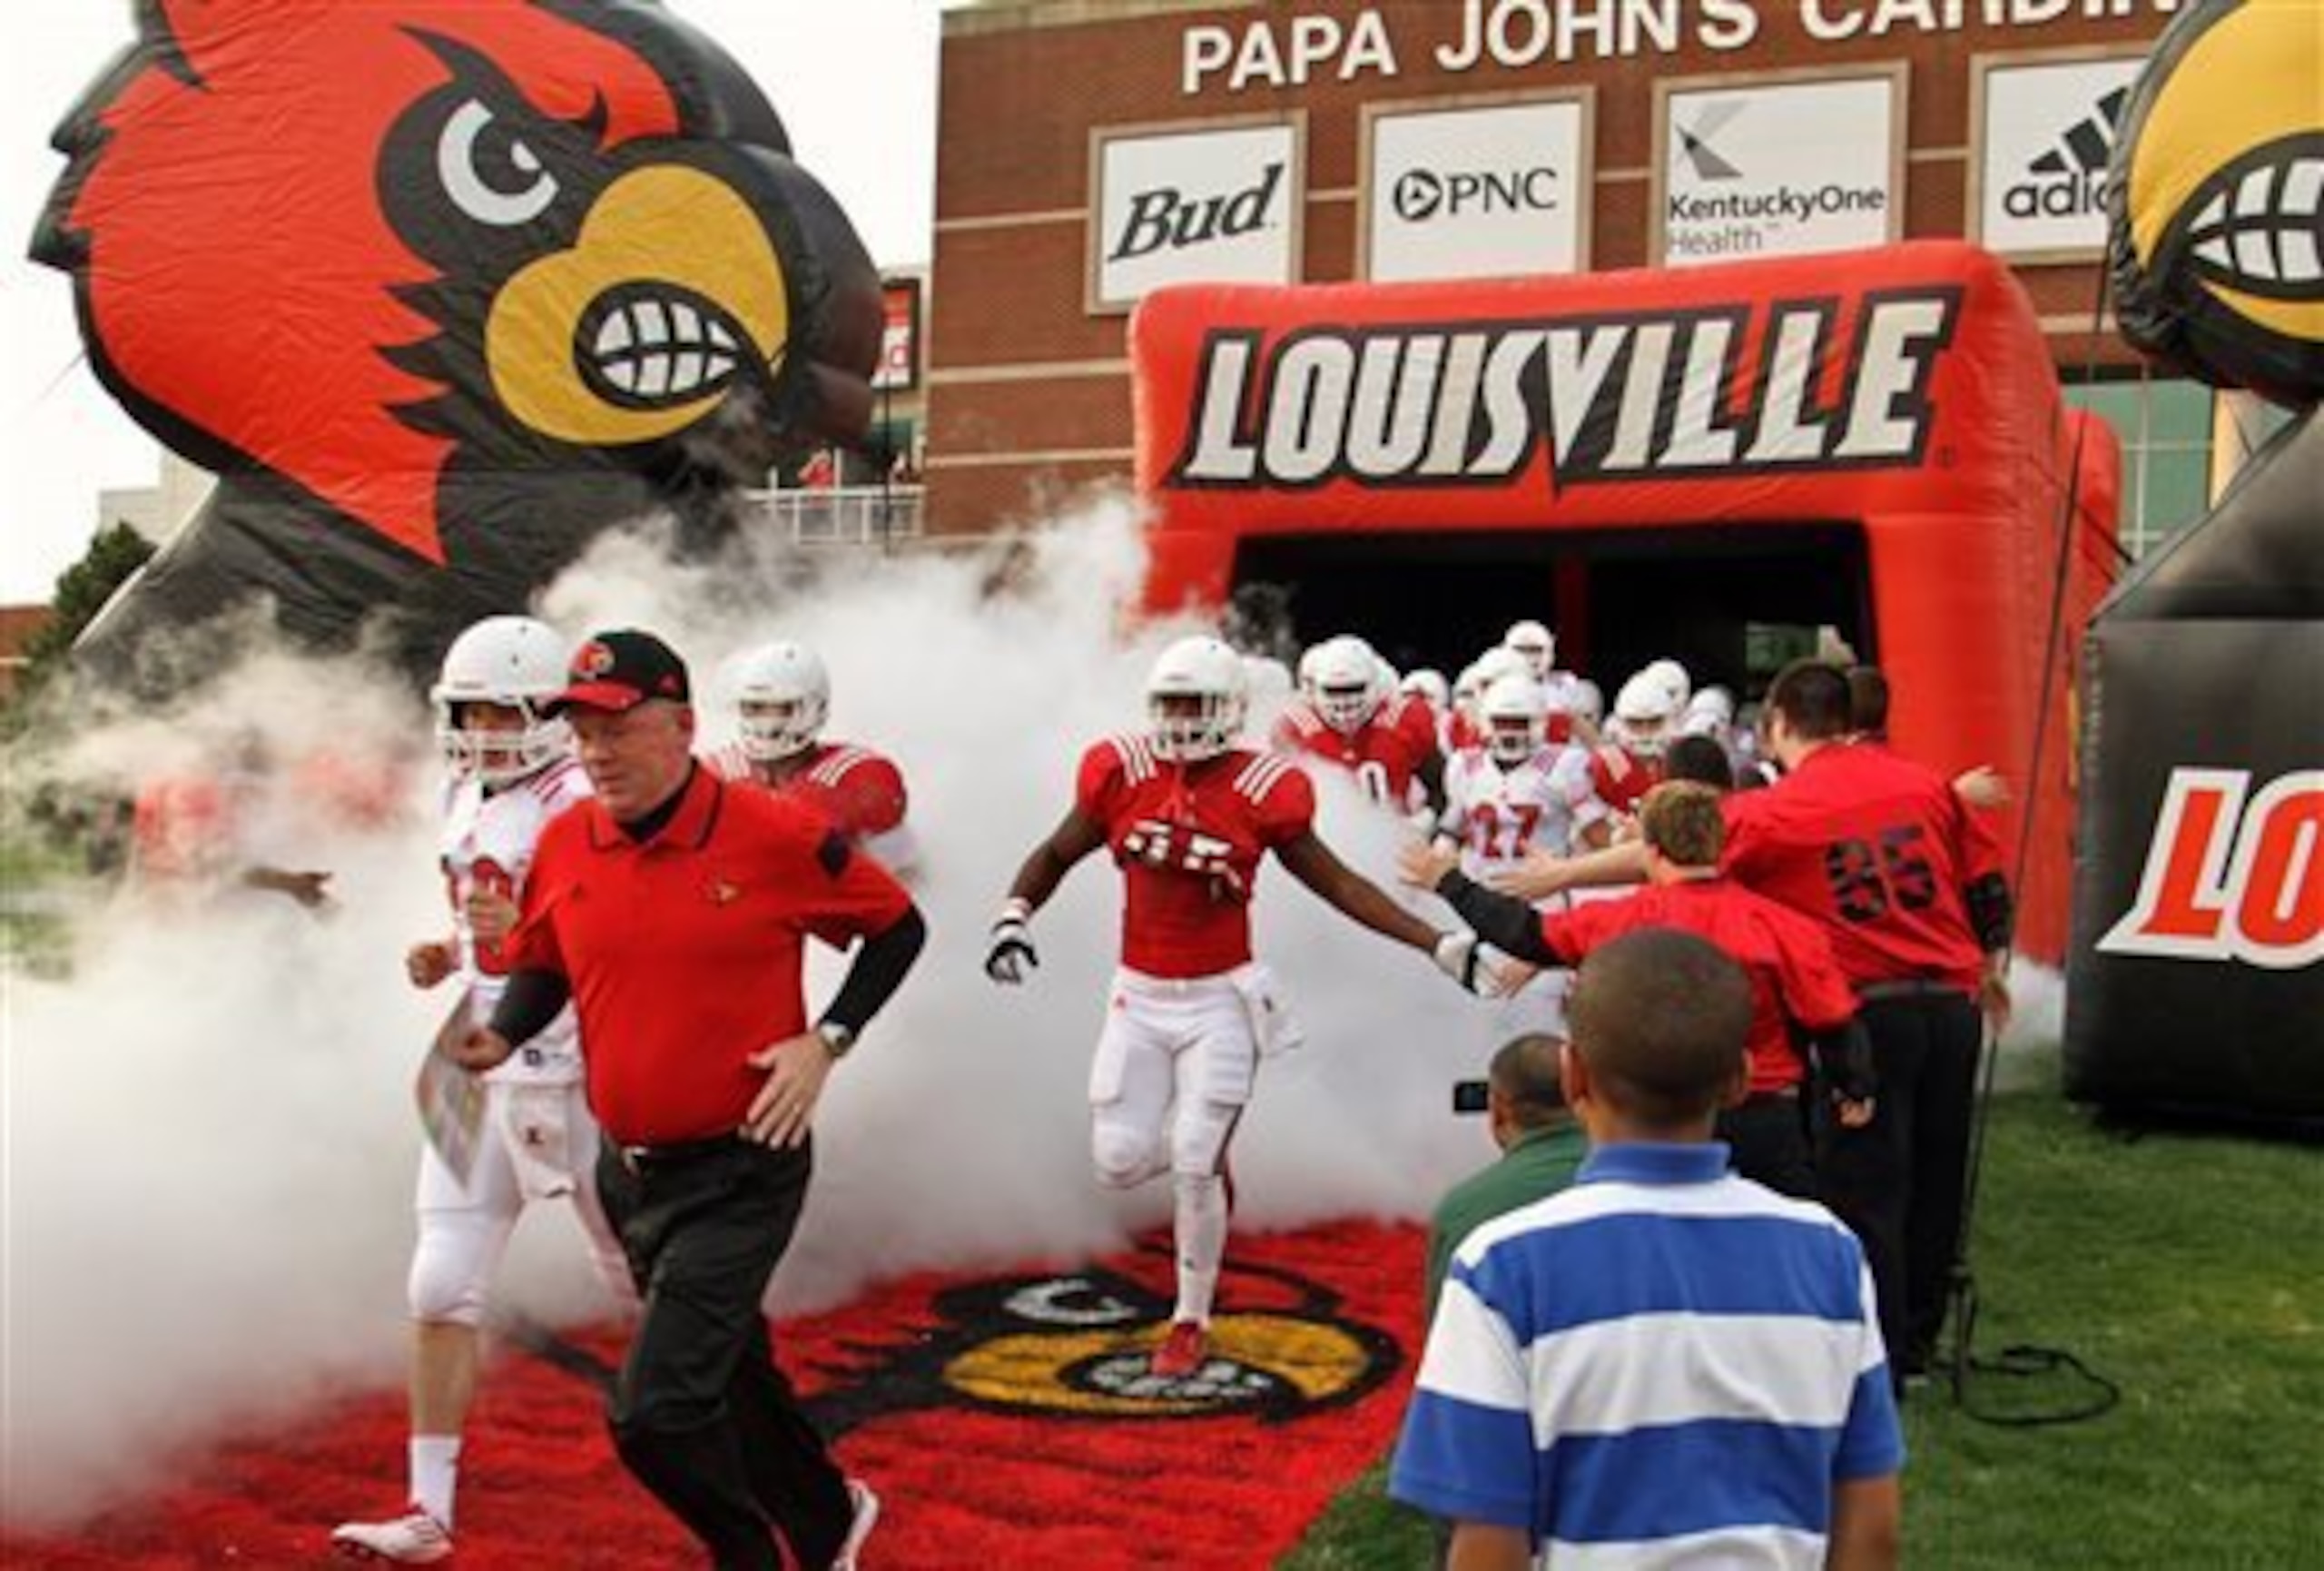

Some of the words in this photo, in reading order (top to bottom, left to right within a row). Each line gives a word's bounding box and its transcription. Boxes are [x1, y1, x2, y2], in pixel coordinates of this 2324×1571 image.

[1182, 12, 1398, 94] PAPA
[1108, 163, 1285, 263] Bud
[1449, 167, 1559, 215] PNC
[1669, 184, 1886, 223] KentuckyOne
[1183, 298, 1947, 483] LOUISVILLE
